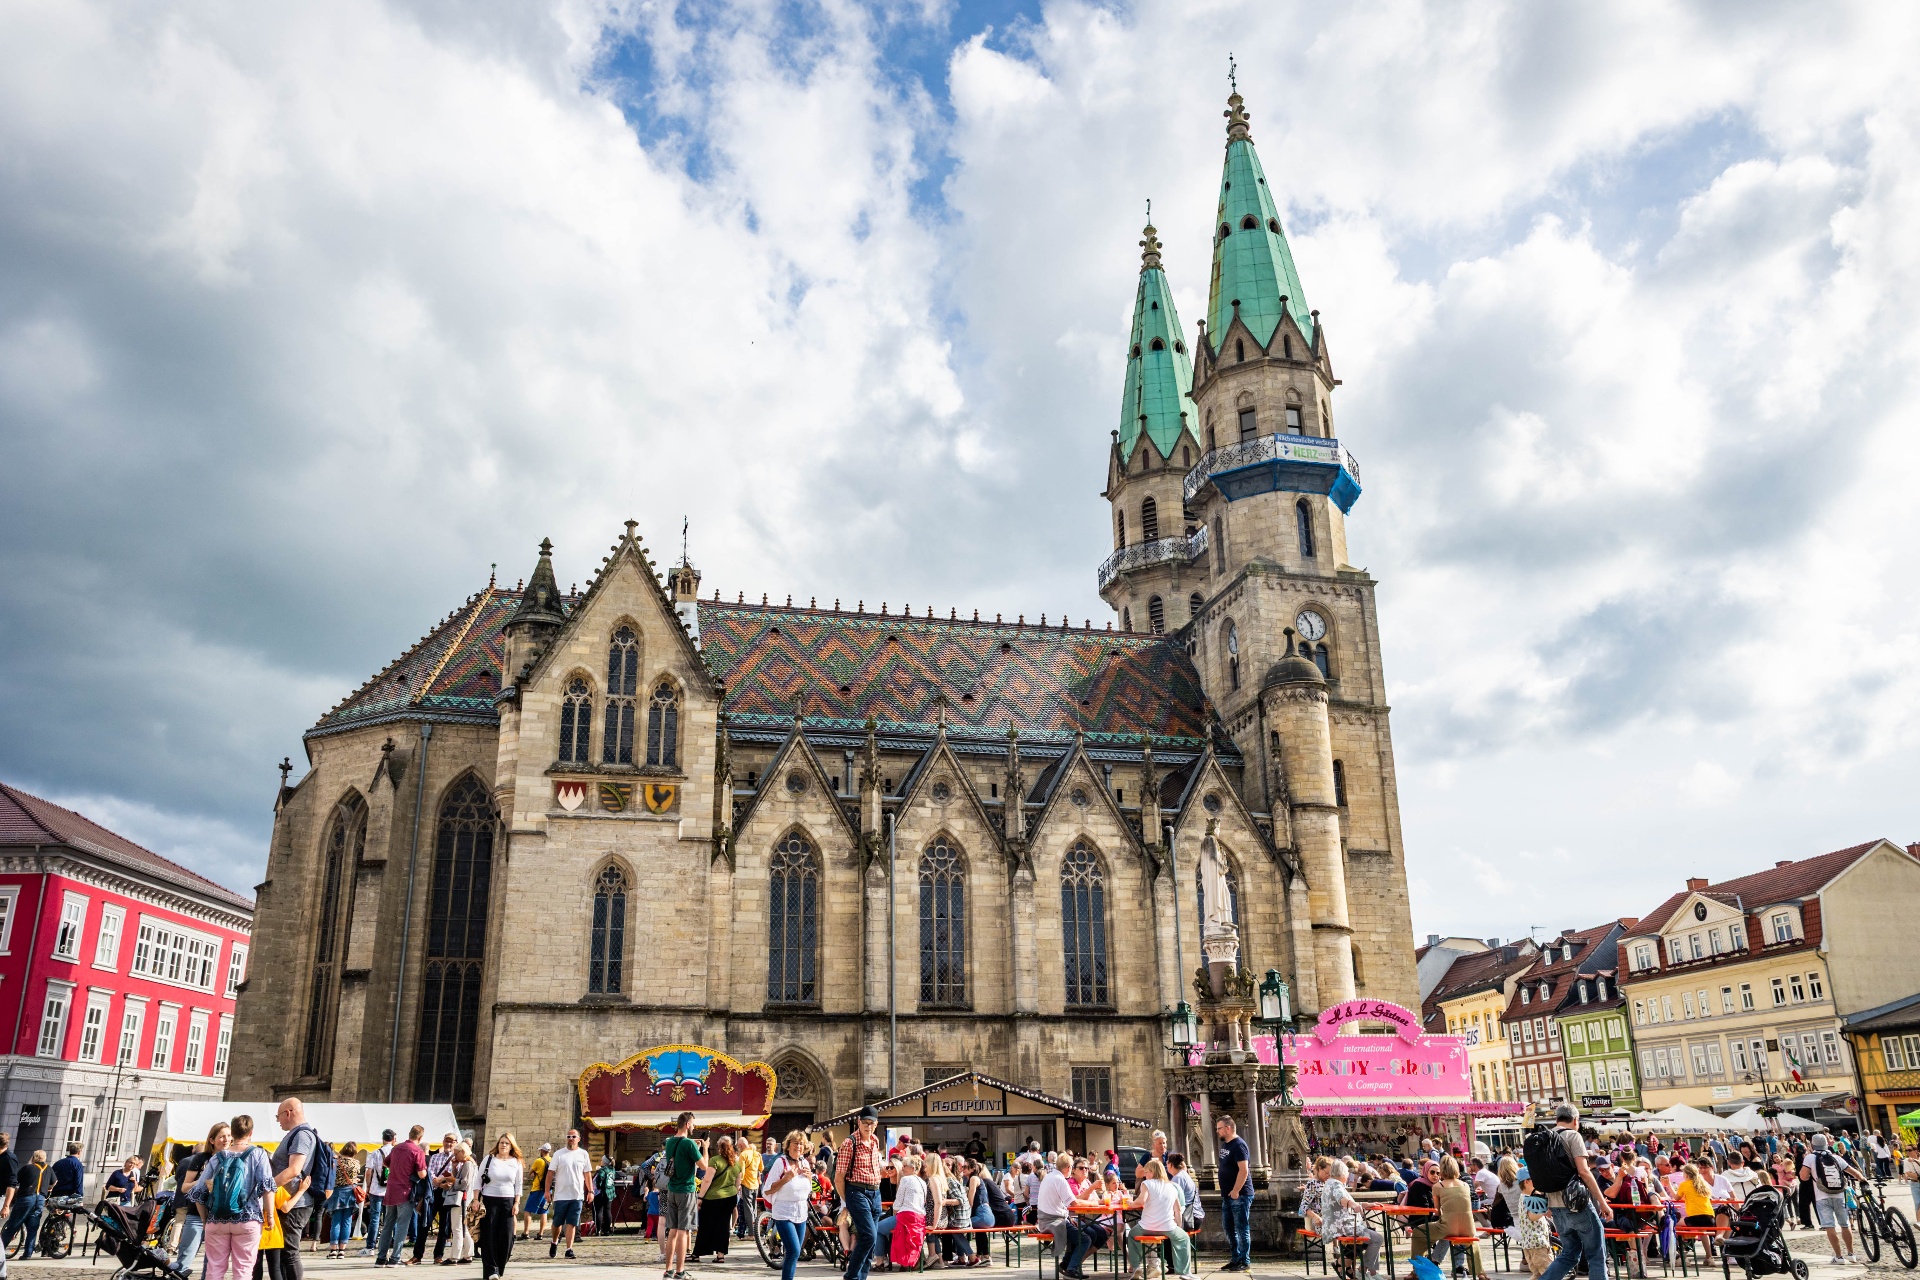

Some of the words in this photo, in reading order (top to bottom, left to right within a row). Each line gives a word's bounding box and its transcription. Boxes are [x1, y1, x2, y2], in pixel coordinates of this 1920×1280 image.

[1293, 446, 1319, 459] HERZ
[1345, 1006, 1352, 1018] &
[1370, 1004, 1410, 1026] Gärtner
[1466, 1029, 1478, 1046] EIS
[1343, 1043, 1393, 1053] international
[1390, 1058, 1446, 1080] Shop
[1347, 1081, 1354, 1090] &
[1355, 1079, 1393, 1092] Company
[1766, 1083, 1781, 1094] LA
[1781, 1081, 1819, 1093] VOGLIA
[931, 1099, 1002, 1112] FISCHPOINT
